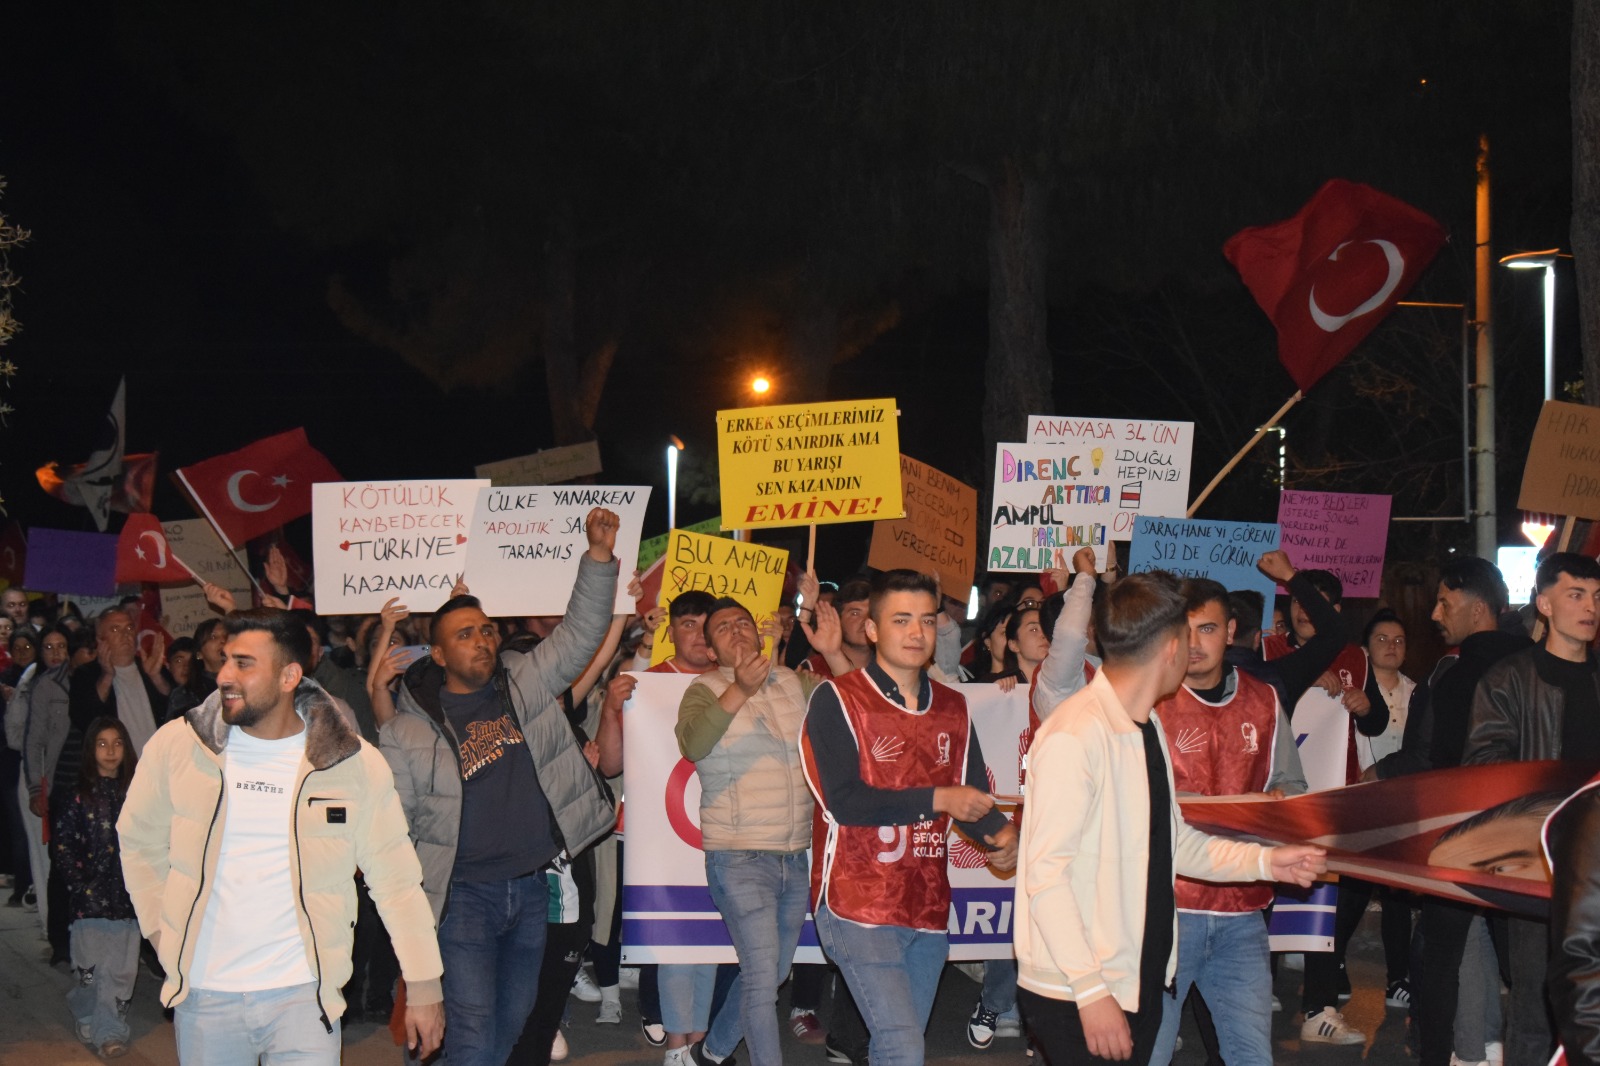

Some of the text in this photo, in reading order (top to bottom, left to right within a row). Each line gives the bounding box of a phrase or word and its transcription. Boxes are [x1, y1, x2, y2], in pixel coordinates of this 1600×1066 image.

[726, 405, 884, 433] ERKEK SEÇİMLERİMİZ
[1034, 420, 1115, 439] ANAYASA
[1547, 410, 1589, 434] HAK
[732, 431, 880, 454] KÖTÜ SANIRDIK AMA
[773, 455, 843, 473] BU YARIŞI
[1003, 449, 1081, 483] DİRENÇ
[343, 484, 454, 510] KÖTÜLÜK
[756, 476, 862, 496] SEN KAZANDIN
[1041, 485, 1110, 505] ARTTIKÇA
[488, 490, 635, 512] ÜLKE YANARKEN
[744, 496, 883, 523] EMİNE!
[339, 513, 466, 533] KAYBEDECEK
[993, 504, 1063, 526] AMPUL
[1032, 523, 1106, 547] PARLAKLIĞI
[350, 533, 456, 561] TÜRKİYE
[497, 542, 573, 563] TARARMIŞ
[675, 534, 714, 564] BU
[724, 545, 784, 575] AMPUL
[1183, 544, 1200, 561] DE
[1209, 540, 1255, 567] GÖRÜN
[691, 572, 757, 597] FAZLA
[236, 782, 284, 794] BREATHE
